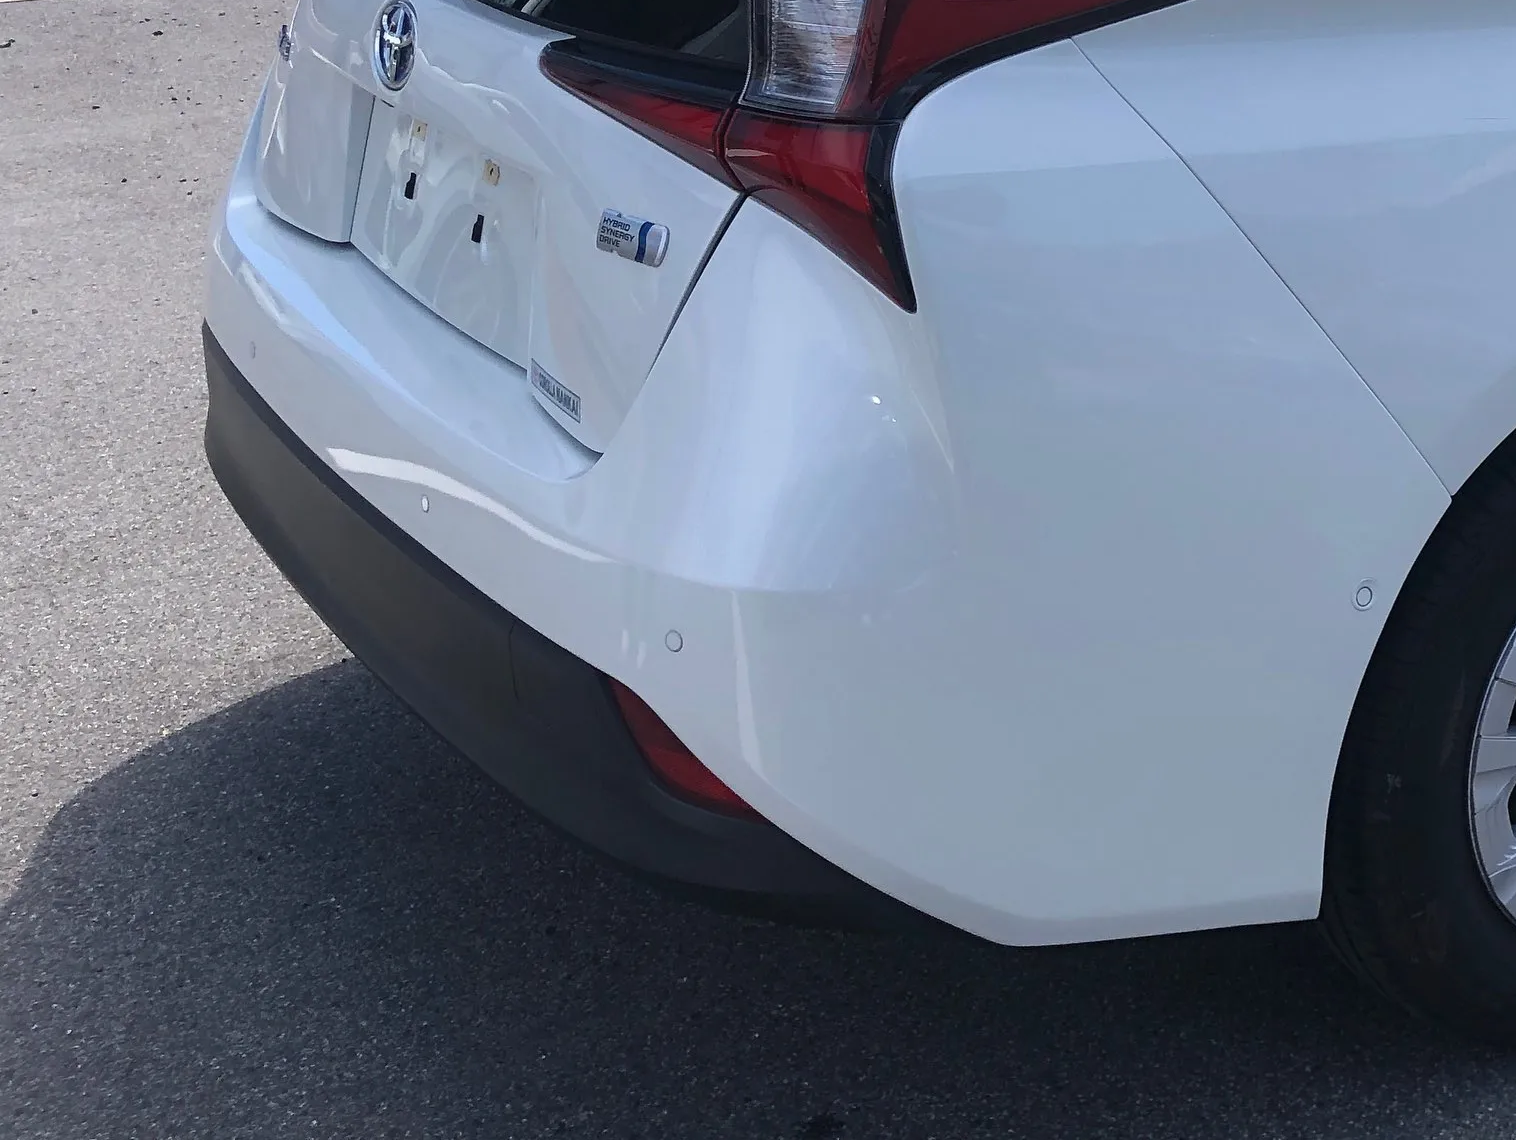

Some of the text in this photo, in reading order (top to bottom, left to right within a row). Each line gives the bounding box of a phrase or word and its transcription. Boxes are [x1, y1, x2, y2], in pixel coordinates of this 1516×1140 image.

[602, 216, 631, 232] HYBRID
[599, 234, 621, 248] DRIVE
[600, 225, 636, 242] SYNERGY
